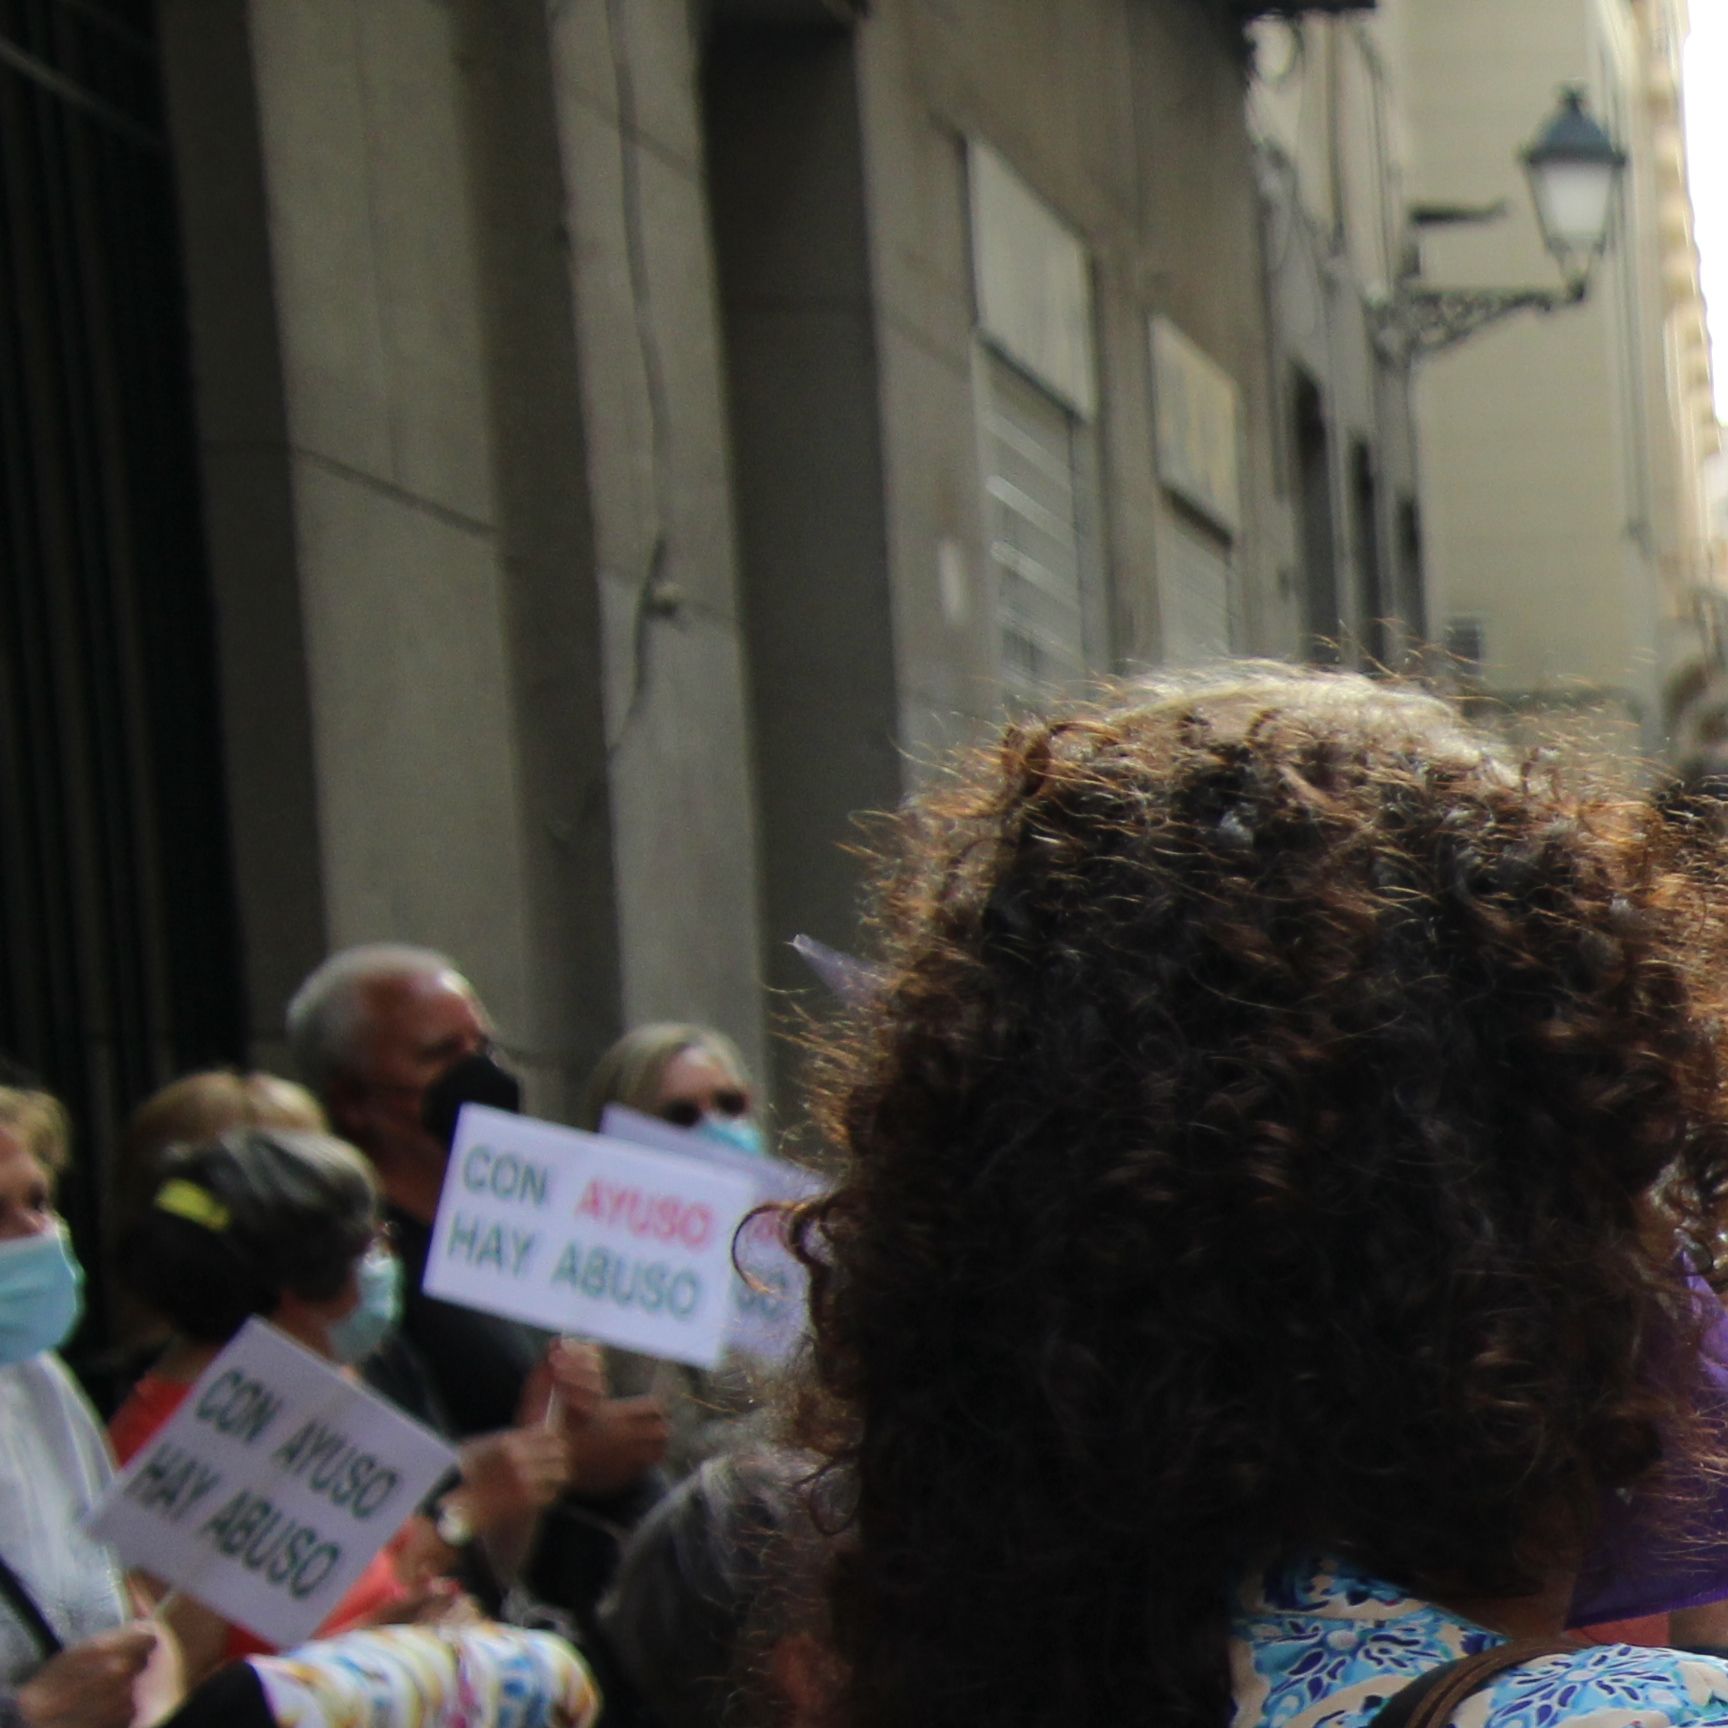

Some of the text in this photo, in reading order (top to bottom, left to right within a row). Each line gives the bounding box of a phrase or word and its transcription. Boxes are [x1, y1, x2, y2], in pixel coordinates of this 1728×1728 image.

[447, 1210, 537, 1277] HAY
[549, 1237, 698, 1321] ABUSO
[463, 1144, 550, 1207] CON
[574, 1176, 712, 1255] AYUSO
[196, 1366, 400, 1520] CON AYUSO
[136, 1442, 341, 1600] HAY ABUSO
